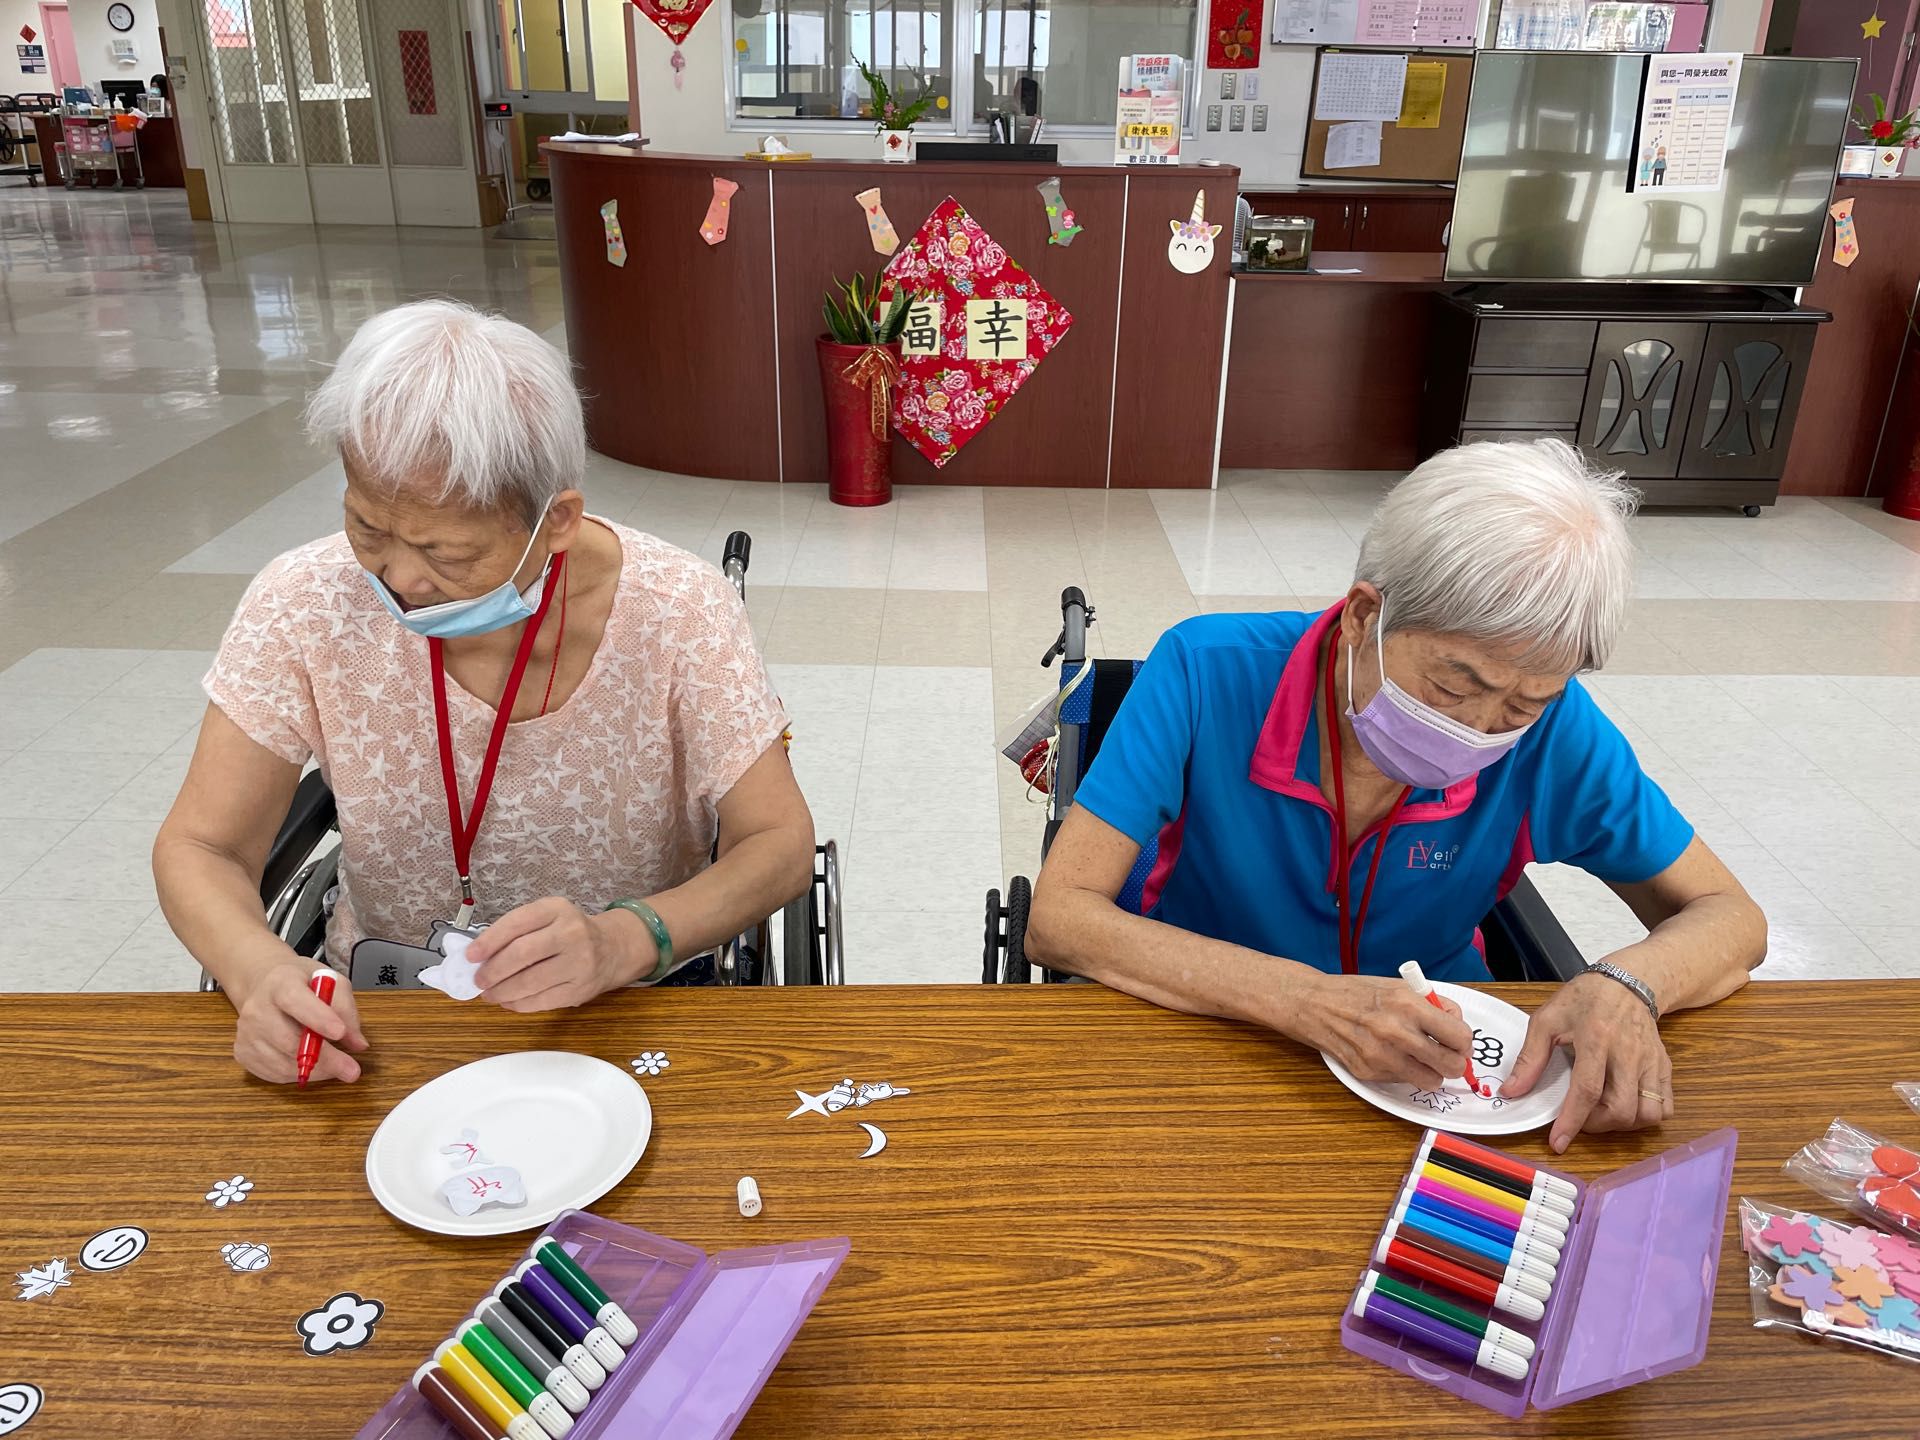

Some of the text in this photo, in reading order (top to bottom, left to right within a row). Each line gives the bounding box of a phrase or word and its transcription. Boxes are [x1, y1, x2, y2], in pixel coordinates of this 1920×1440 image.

[1131, 125, 1169, 136] 衛教單張
[1129, 155, 1168, 164] 歡迎取閱
